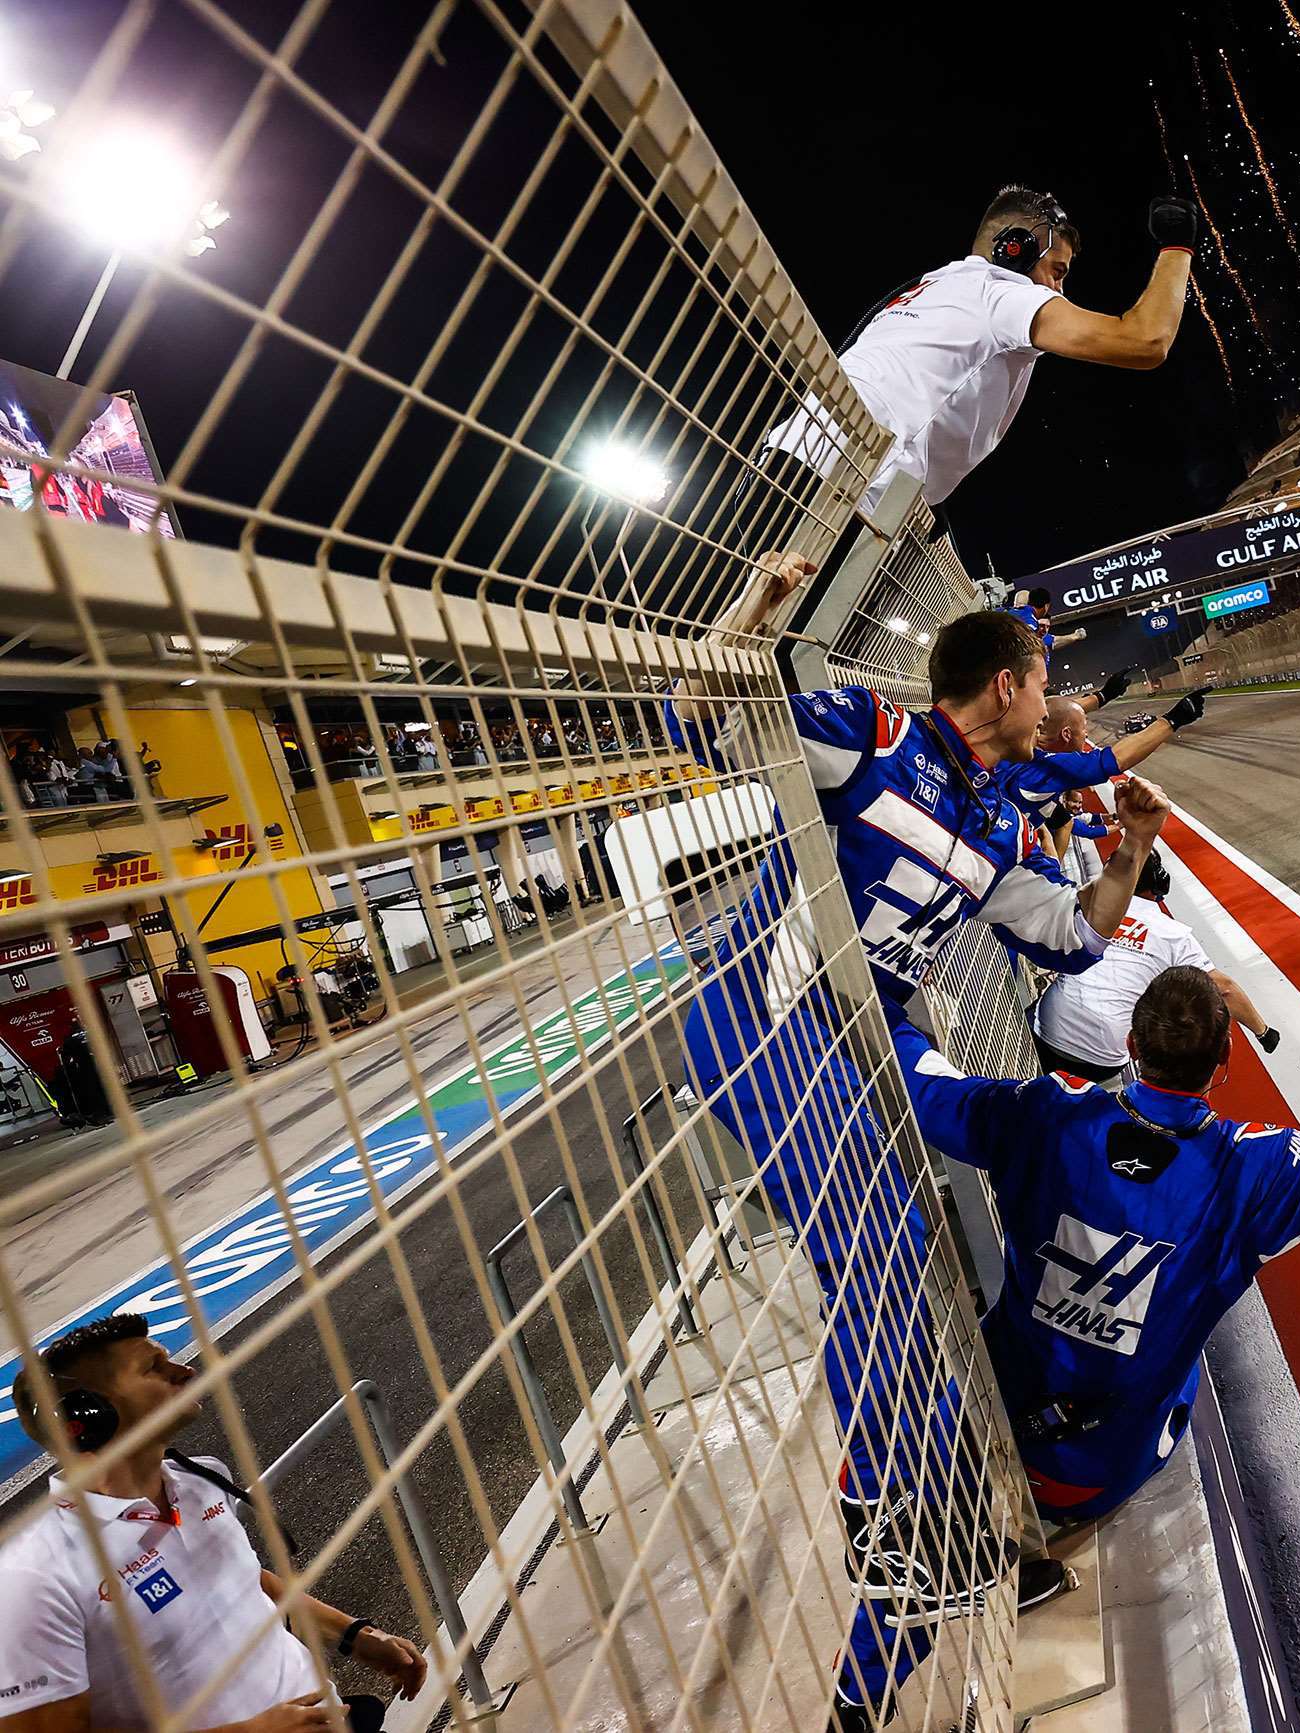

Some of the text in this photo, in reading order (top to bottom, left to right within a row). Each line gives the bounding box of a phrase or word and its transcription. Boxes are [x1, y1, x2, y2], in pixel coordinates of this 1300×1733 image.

[1245, 516, 1280, 541] الخليج
[1092, 547, 1162, 580] طيران الخليج
[1216, 539, 1276, 568] GULF
[1062, 567, 1170, 608] GULF AIR
[1207, 587, 1264, 613] aramco
[1150, 617, 1169, 629] FIA
[1060, 682, 1095, 697] GULF AIR
[918, 780, 938, 804] 1&1
[92, 858, 159, 892] DHL
[12, 973, 27, 989] 30
[1035, 1298, 1144, 1345] HAAS
[201, 1501, 225, 1522] HAAS
[118, 1548, 159, 1580] Haas
[140, 1555, 166, 1575] Team
[142, 1576, 174, 1603] 1&1
